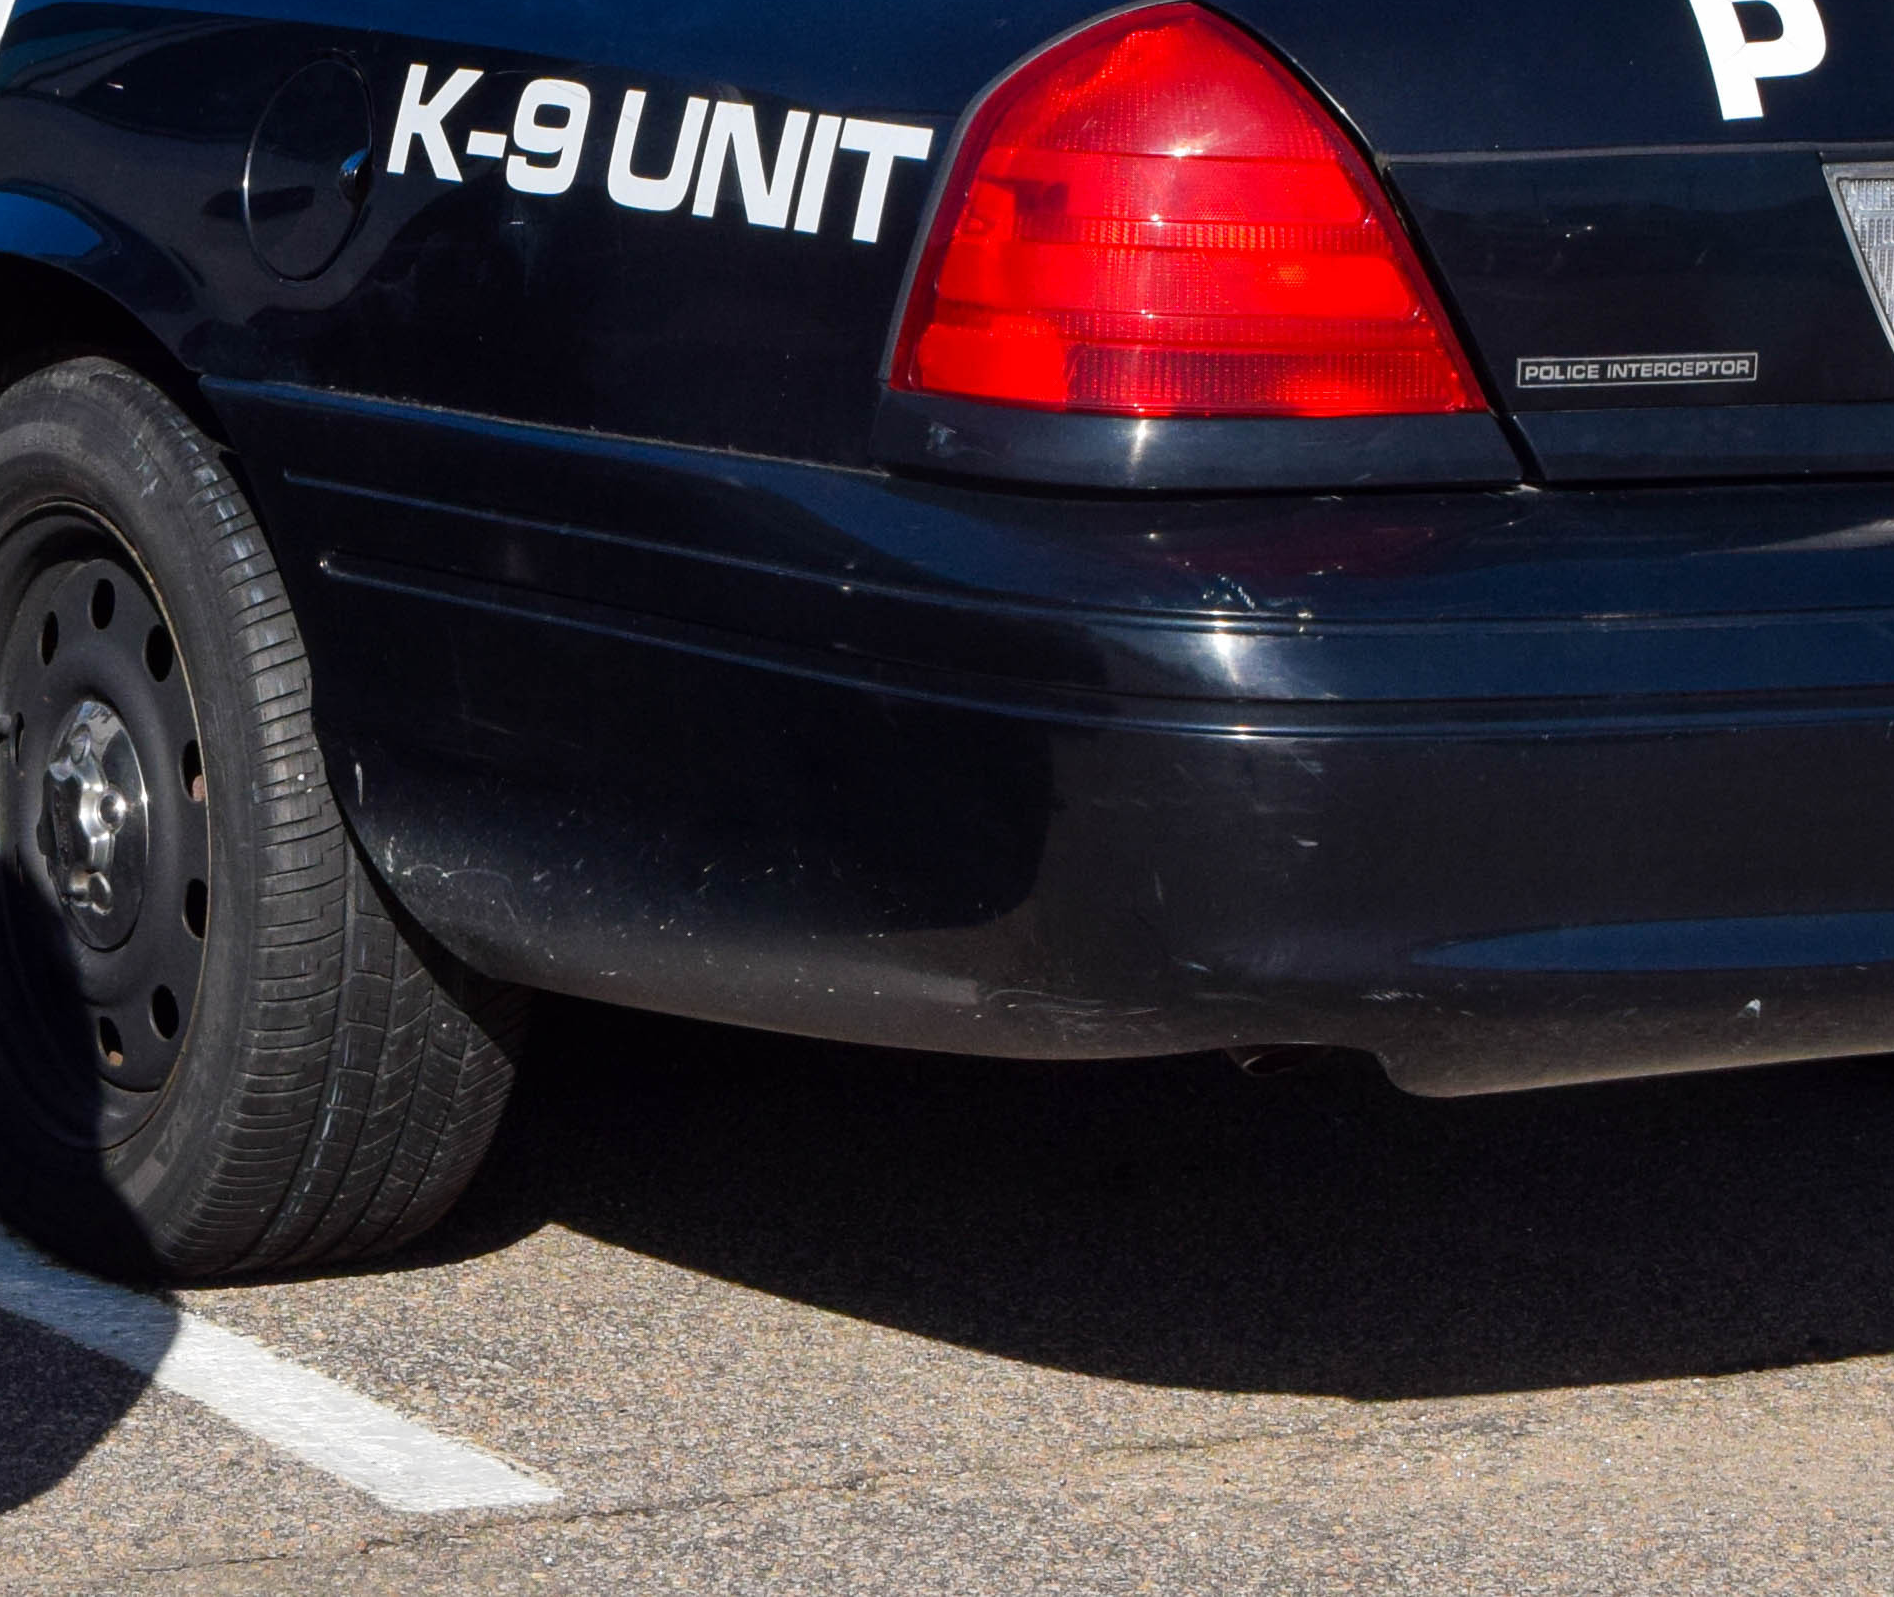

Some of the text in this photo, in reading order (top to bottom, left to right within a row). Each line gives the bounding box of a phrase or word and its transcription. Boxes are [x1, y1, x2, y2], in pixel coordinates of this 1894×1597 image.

[387, 63, 933, 243] K-9 UNIT
[1524, 360, 1749, 381] POLICE INTERCEPTOR
